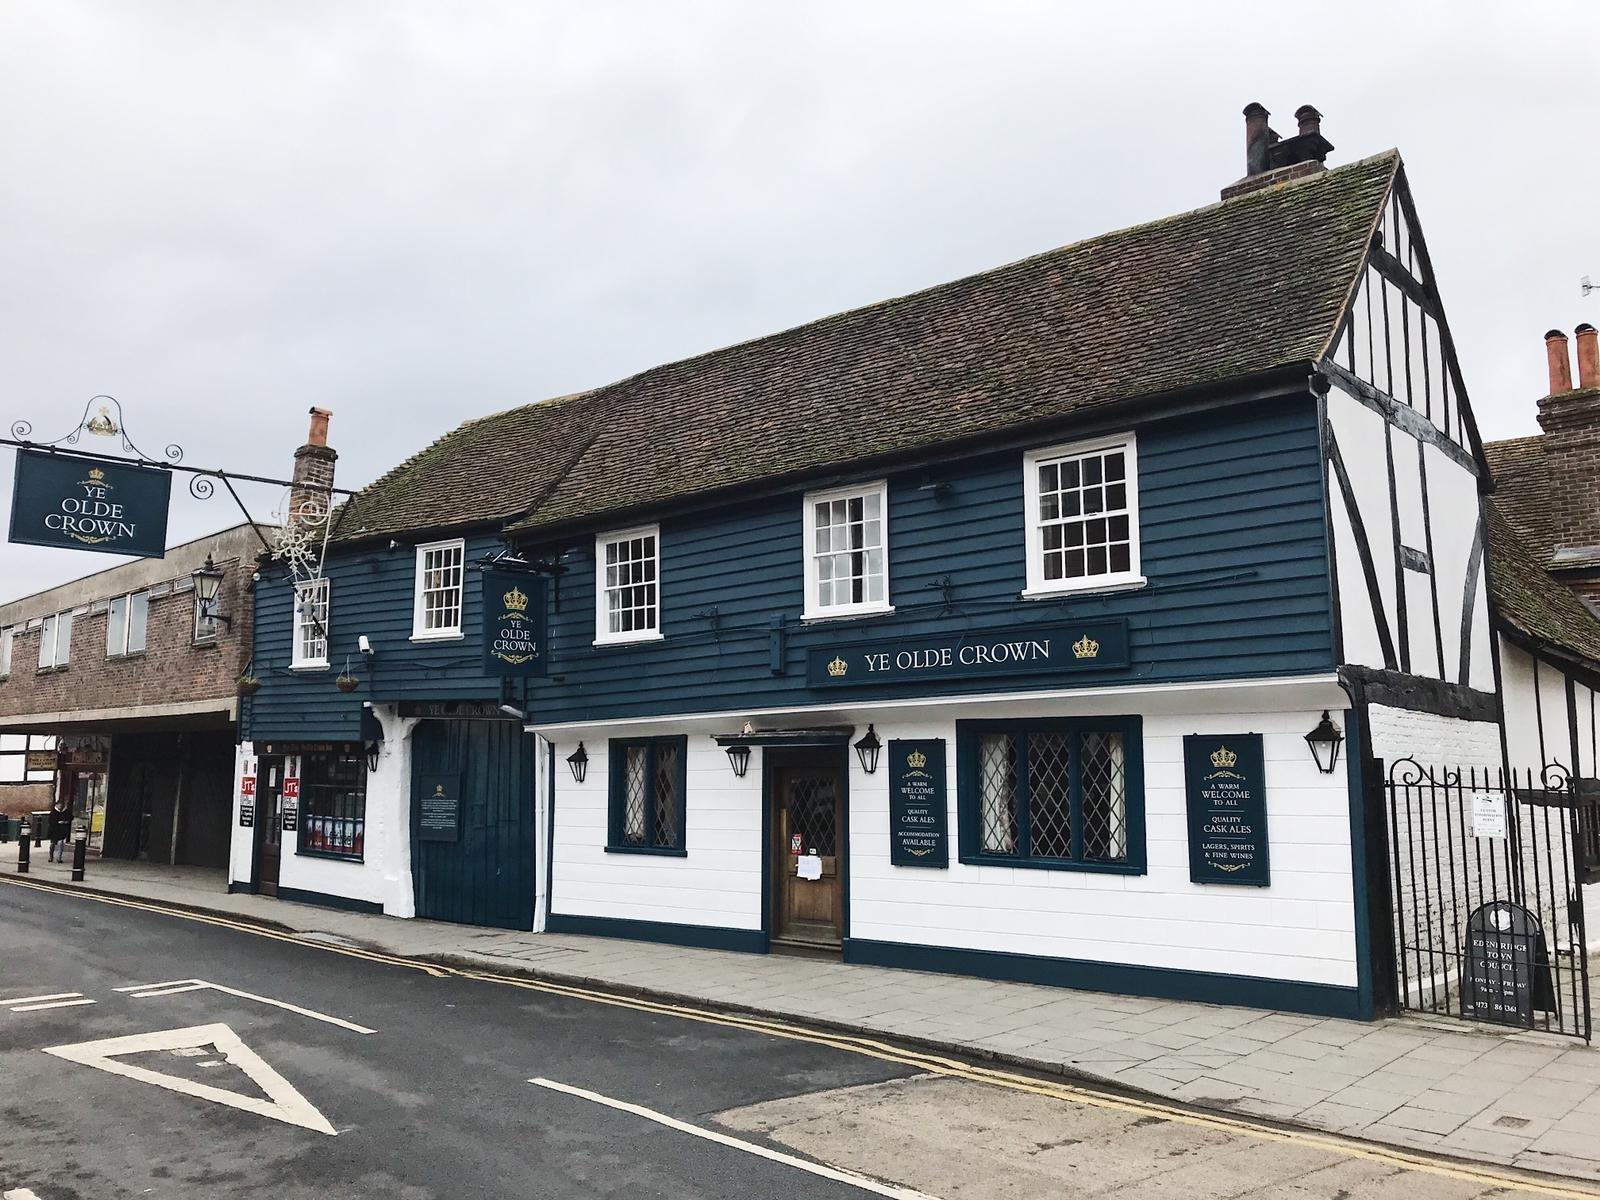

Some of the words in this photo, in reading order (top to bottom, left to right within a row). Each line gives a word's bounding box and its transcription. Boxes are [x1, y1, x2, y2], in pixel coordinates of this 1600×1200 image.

[84, 486, 106, 499] YE
[61, 498, 123, 519] OLDE
[44, 514, 136, 538] CROWN
[510, 620, 521, 628] YE
[500, 628, 530, 640] OLDE
[493, 639, 536, 652] CROWN
[864, 653, 891, 672] YE
[896, 648, 953, 670] OLDE
[959, 640, 1050, 665] CROWN
[1201, 790, 1250, 799] WELCOME
[1211, 816, 1241, 824] QUALITY
[1203, 825, 1228, 833] CASK
[1229, 825, 1252, 834] ALES
